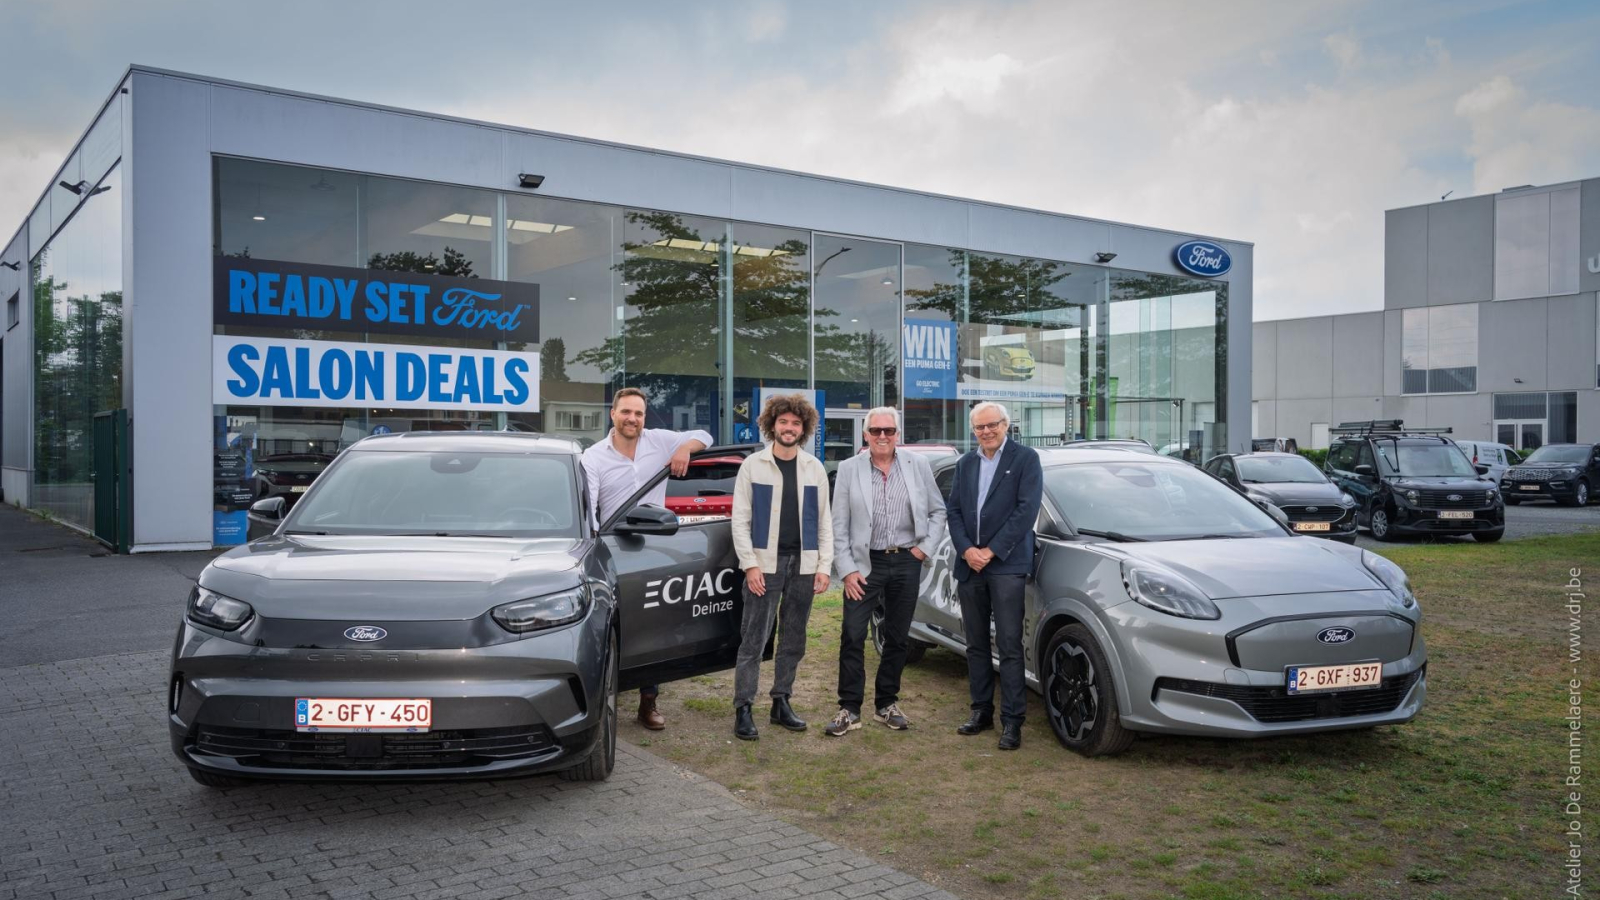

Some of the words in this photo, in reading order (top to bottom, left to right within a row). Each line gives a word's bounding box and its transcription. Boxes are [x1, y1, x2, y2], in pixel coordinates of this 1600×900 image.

[1189, 245, 1222, 269] Ford
[229, 269, 358, 321] READY
[365, 281, 430, 325] SET
[904, 324, 951, 360] WIN
[227, 343, 385, 401] SALON
[396, 352, 529, 405] DEALS
[905, 358, 916, 368] EEN
[917, 359, 934, 369] PUMA
[644, 568, 735, 609] ECIAC
[692, 600, 733, 618] Deinze
[352, 627, 379, 639] Ford
[1324, 630, 1348, 642] Ford
[1299, 666, 1378, 687] 2-GXF-937
[298, 714, 306, 723] B
[311, 703, 428, 722] 2-GFY-450
